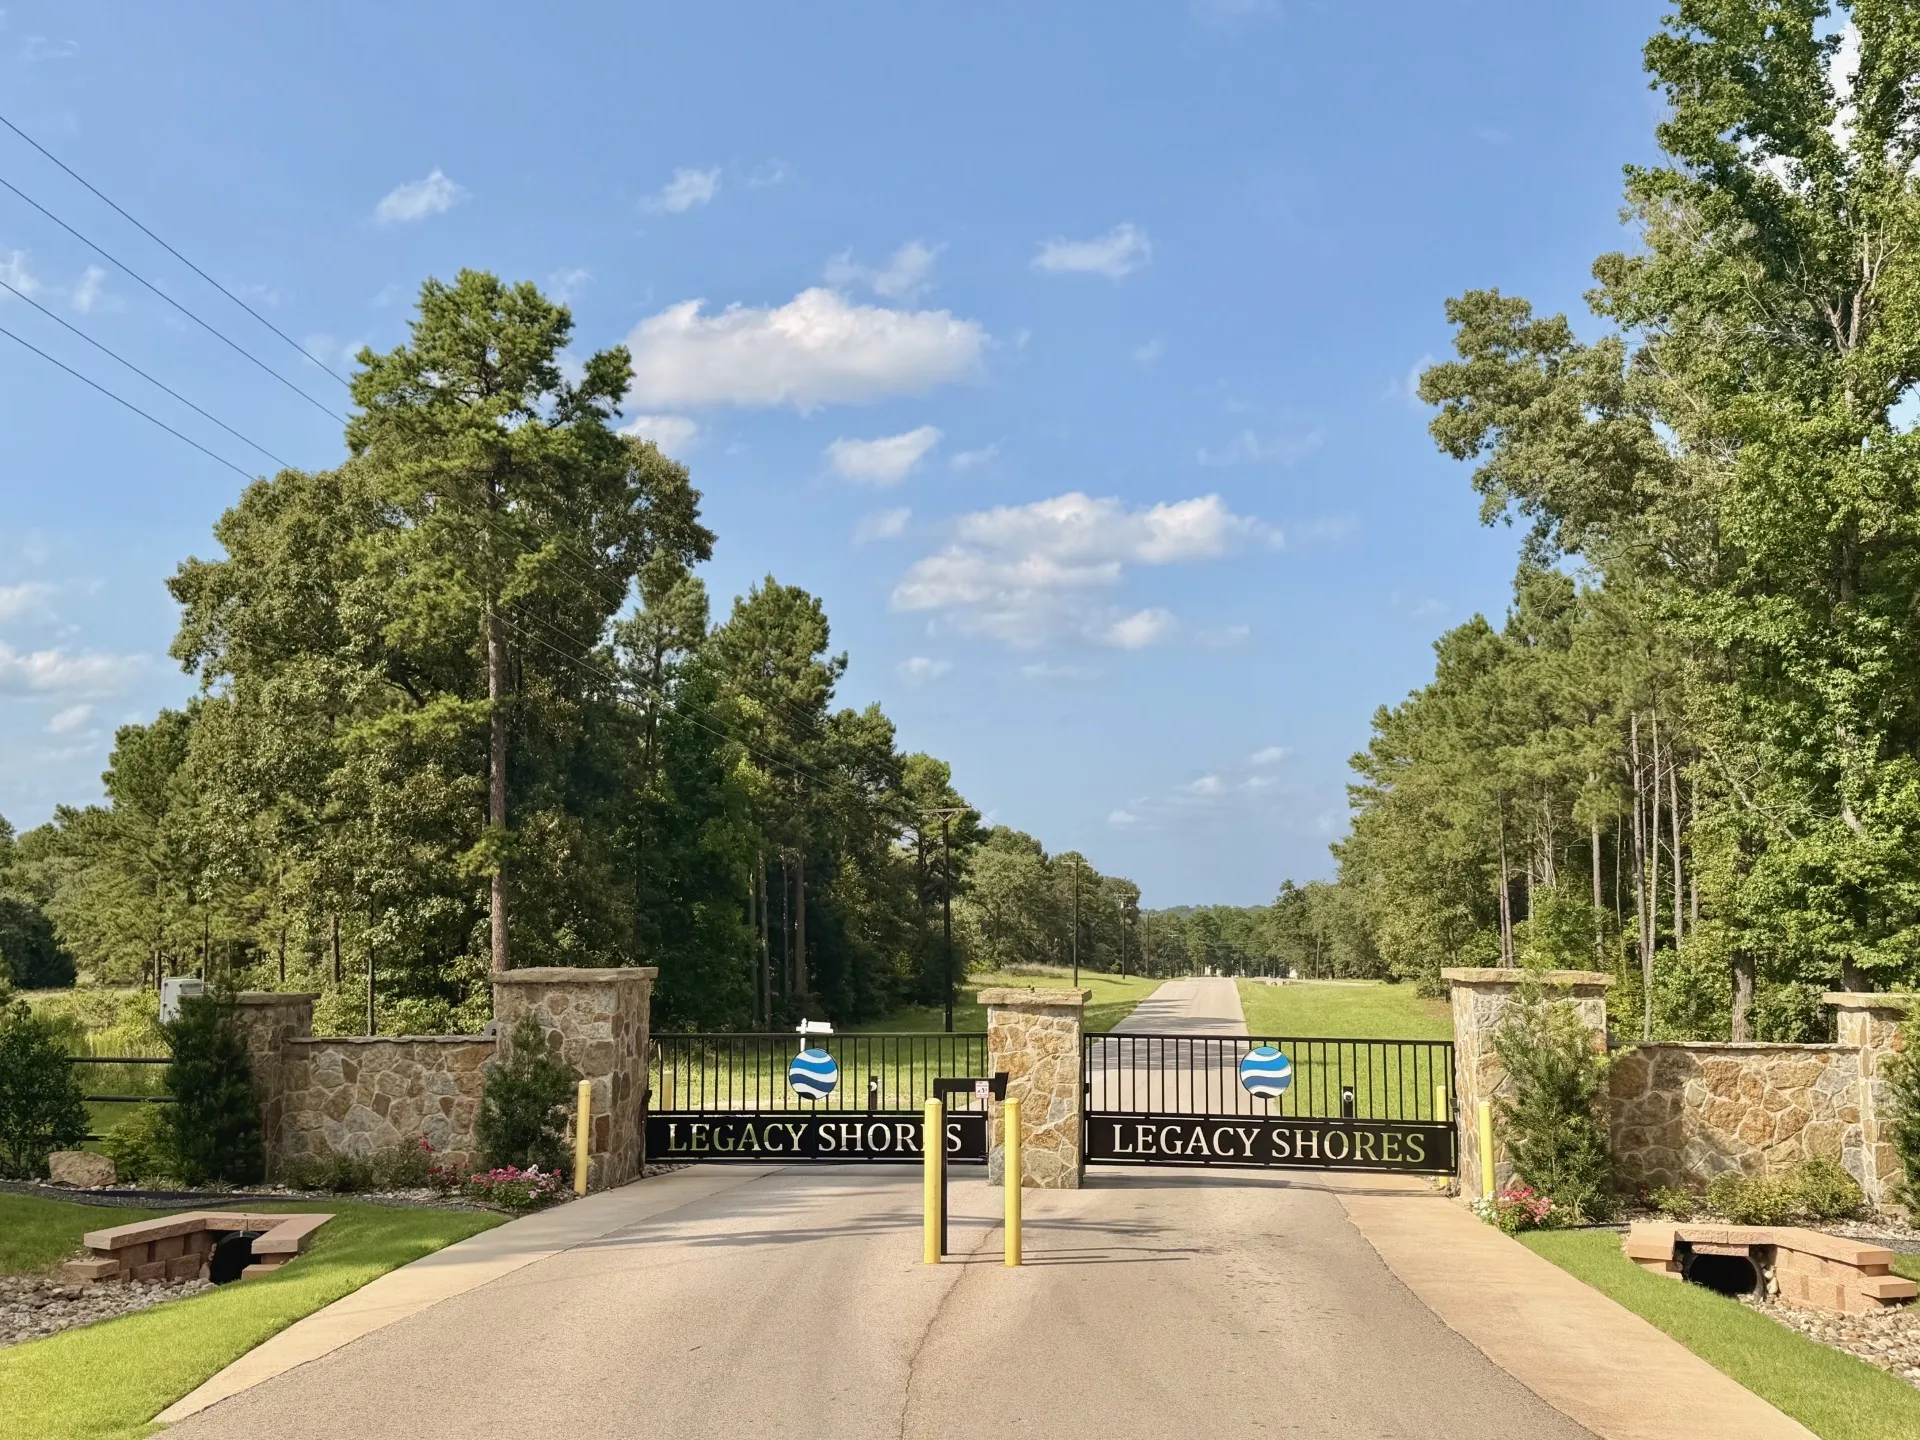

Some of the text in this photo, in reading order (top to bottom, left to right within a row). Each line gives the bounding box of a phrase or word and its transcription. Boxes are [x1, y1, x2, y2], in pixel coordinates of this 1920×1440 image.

[667, 1123, 962, 1152] LEGACY SHORS
[1112, 1124, 1425, 1163] LEGACY SHORES
